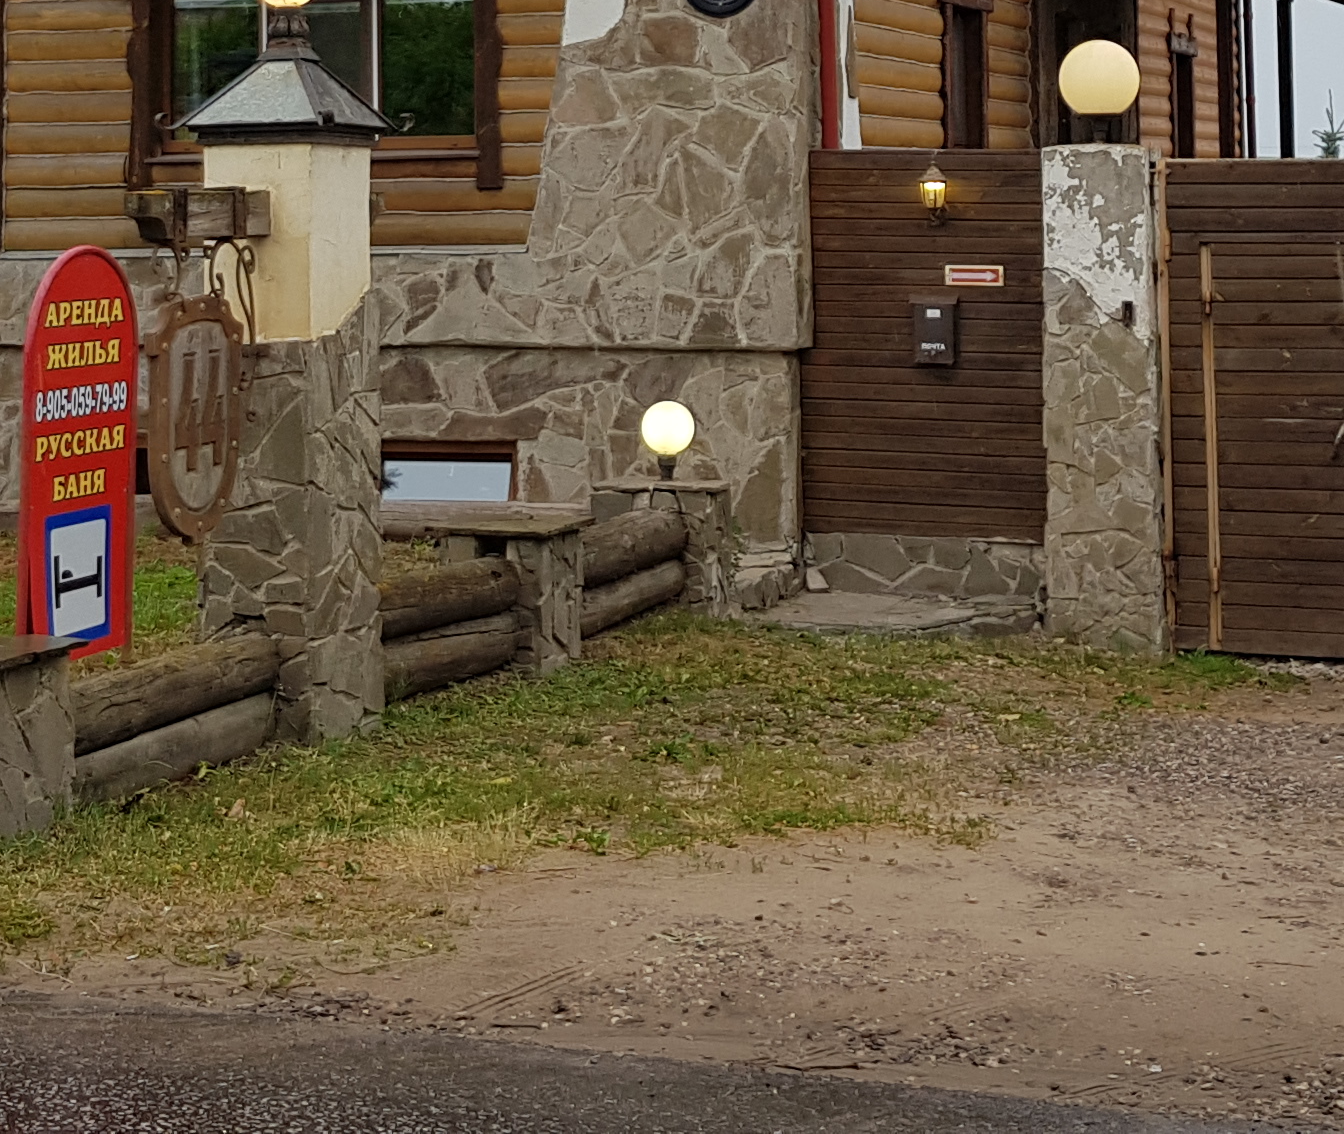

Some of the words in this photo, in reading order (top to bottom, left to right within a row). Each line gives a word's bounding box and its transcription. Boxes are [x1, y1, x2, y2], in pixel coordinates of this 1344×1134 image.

[44, 298, 124, 329] АРЕНДА
[46, 338, 120, 371] ЖИЛЬЯ
[35, 381, 128, 424] 8-905-059-79-99
[175, 349, 225, 472] 44
[35, 424, 126, 463] РУССКАЯ
[52, 468, 106, 503] БАНЯ
